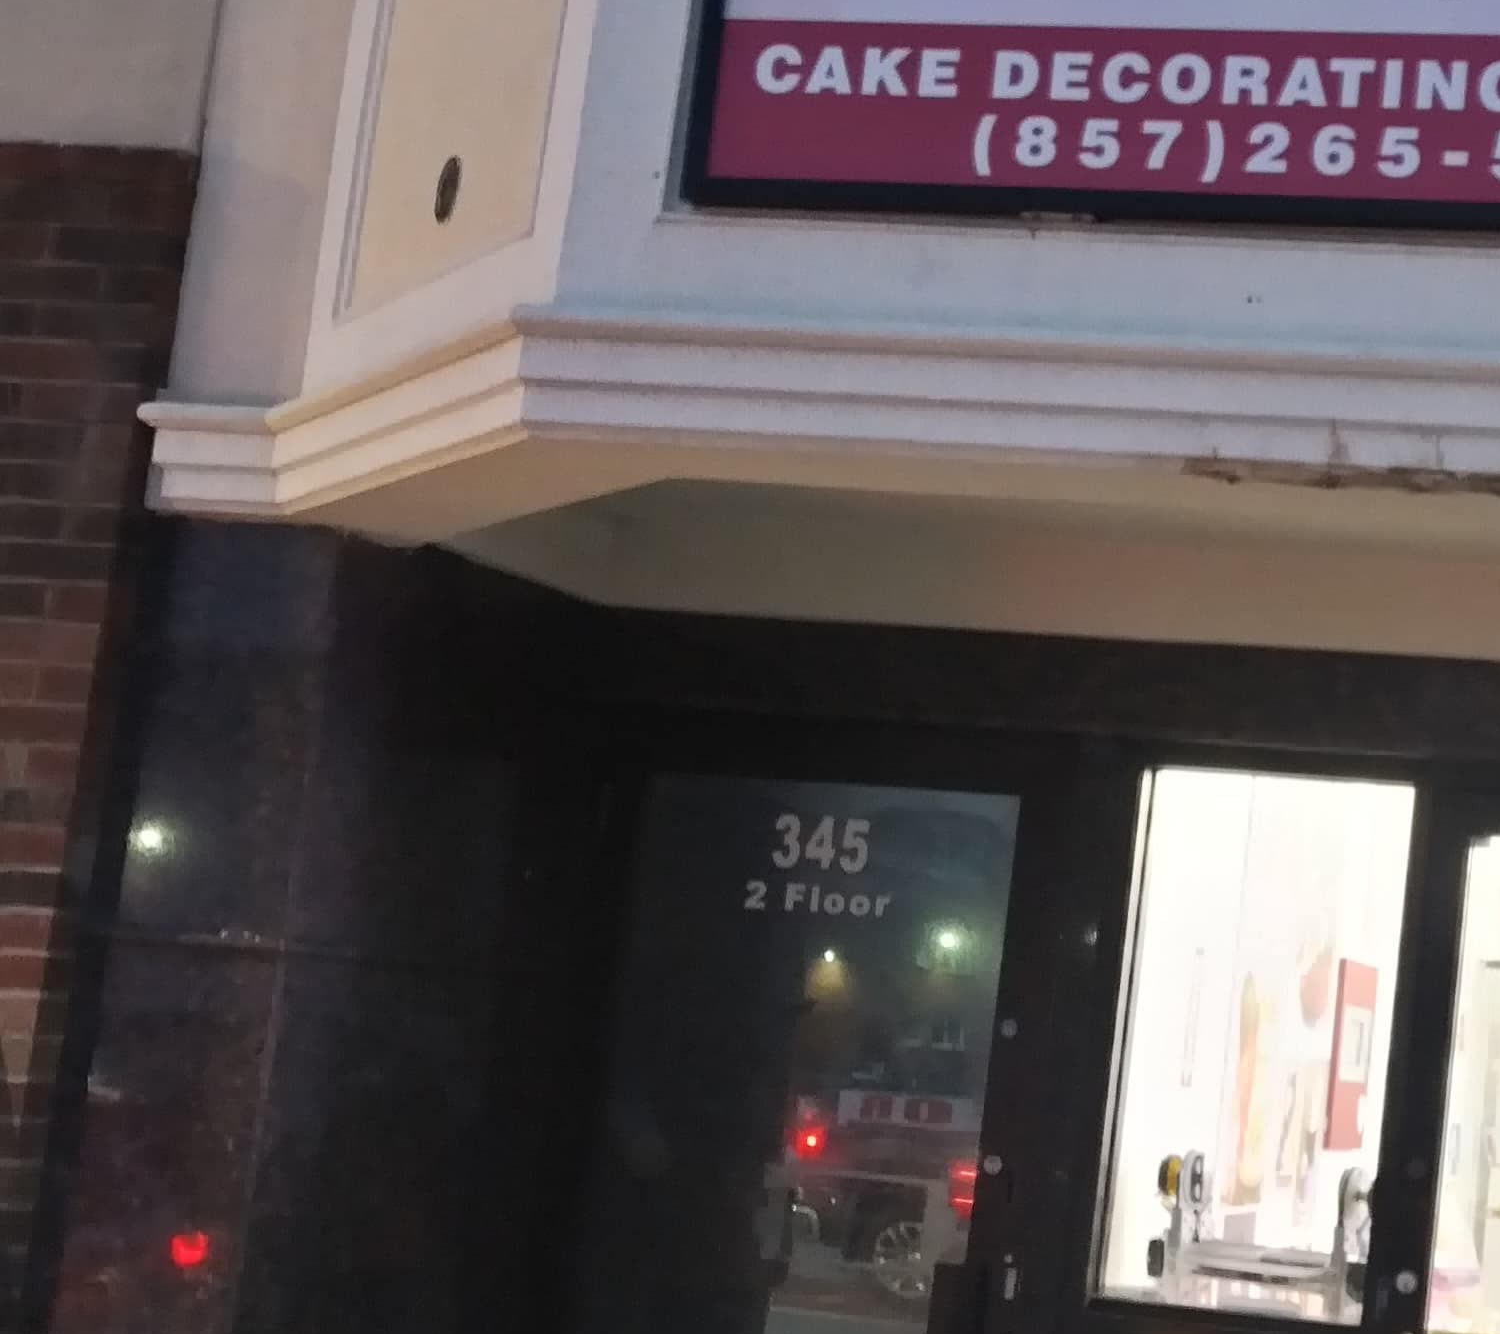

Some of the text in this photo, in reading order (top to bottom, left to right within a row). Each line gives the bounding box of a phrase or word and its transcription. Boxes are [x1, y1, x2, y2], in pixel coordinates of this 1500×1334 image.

[755, 44, 960, 99] CAKE
[772, 813, 870, 874] 345
[744, 880, 891, 917] 2 Floor
